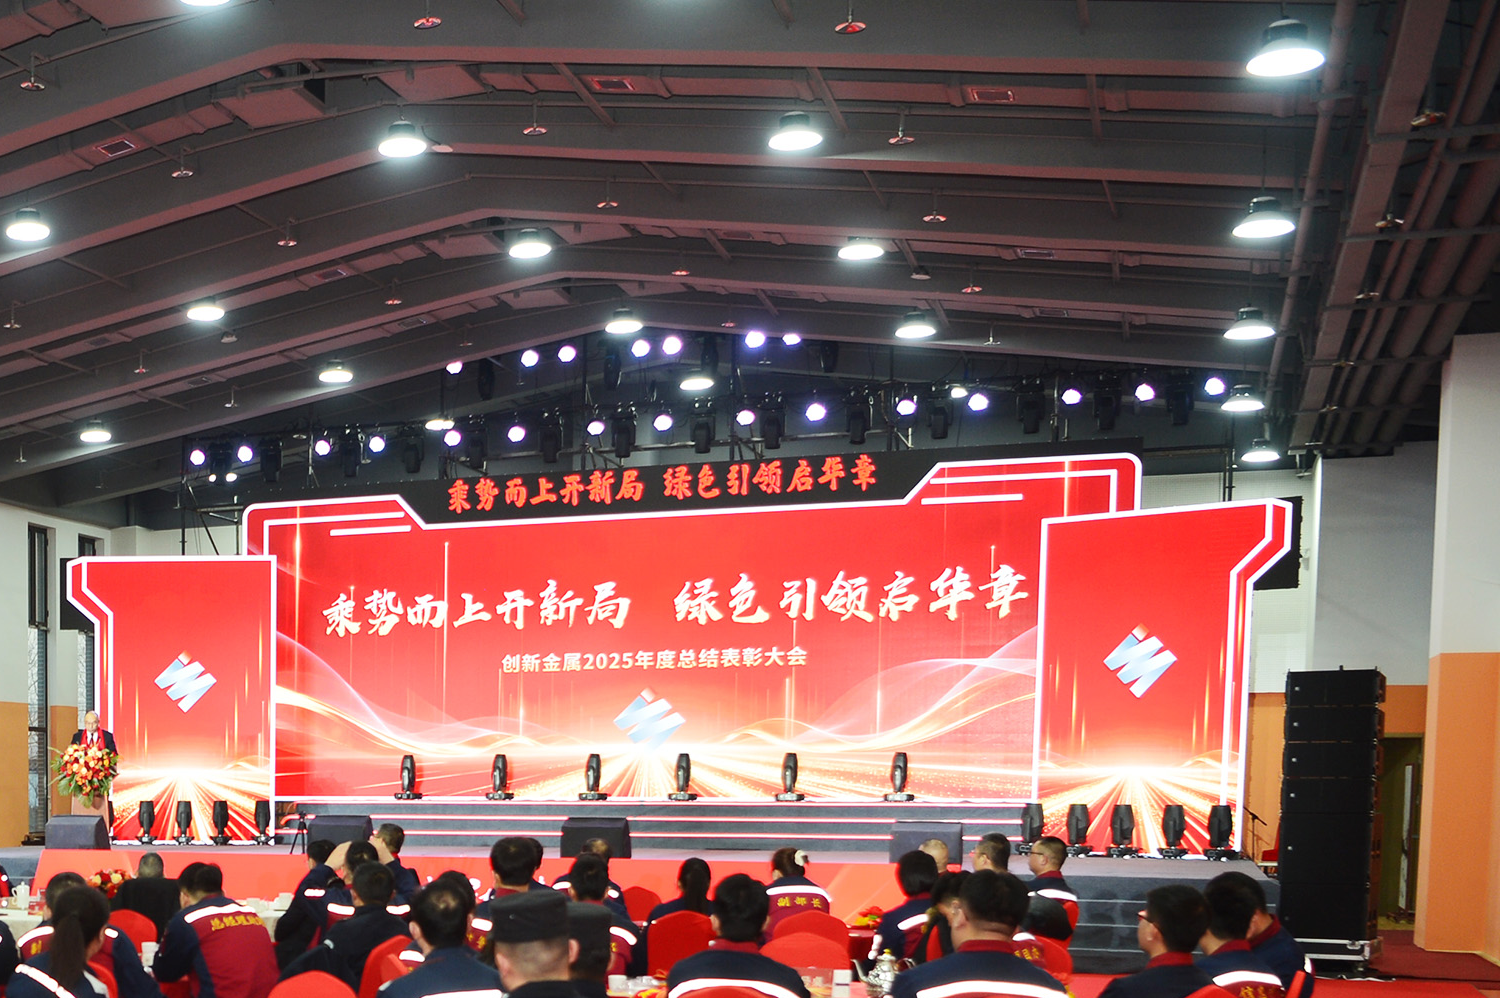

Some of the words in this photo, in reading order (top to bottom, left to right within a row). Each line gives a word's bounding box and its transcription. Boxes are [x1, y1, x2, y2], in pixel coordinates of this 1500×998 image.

[447, 468, 645, 514] 乘势而上开新局
[662, 454, 878, 501] 绿色引领启华章
[322, 579, 631, 638] 乘势而上开新局
[673, 564, 1029, 626] 绿色引领启华章
[501, 646, 808, 674] 创新金属2025年度总结表彰大会
